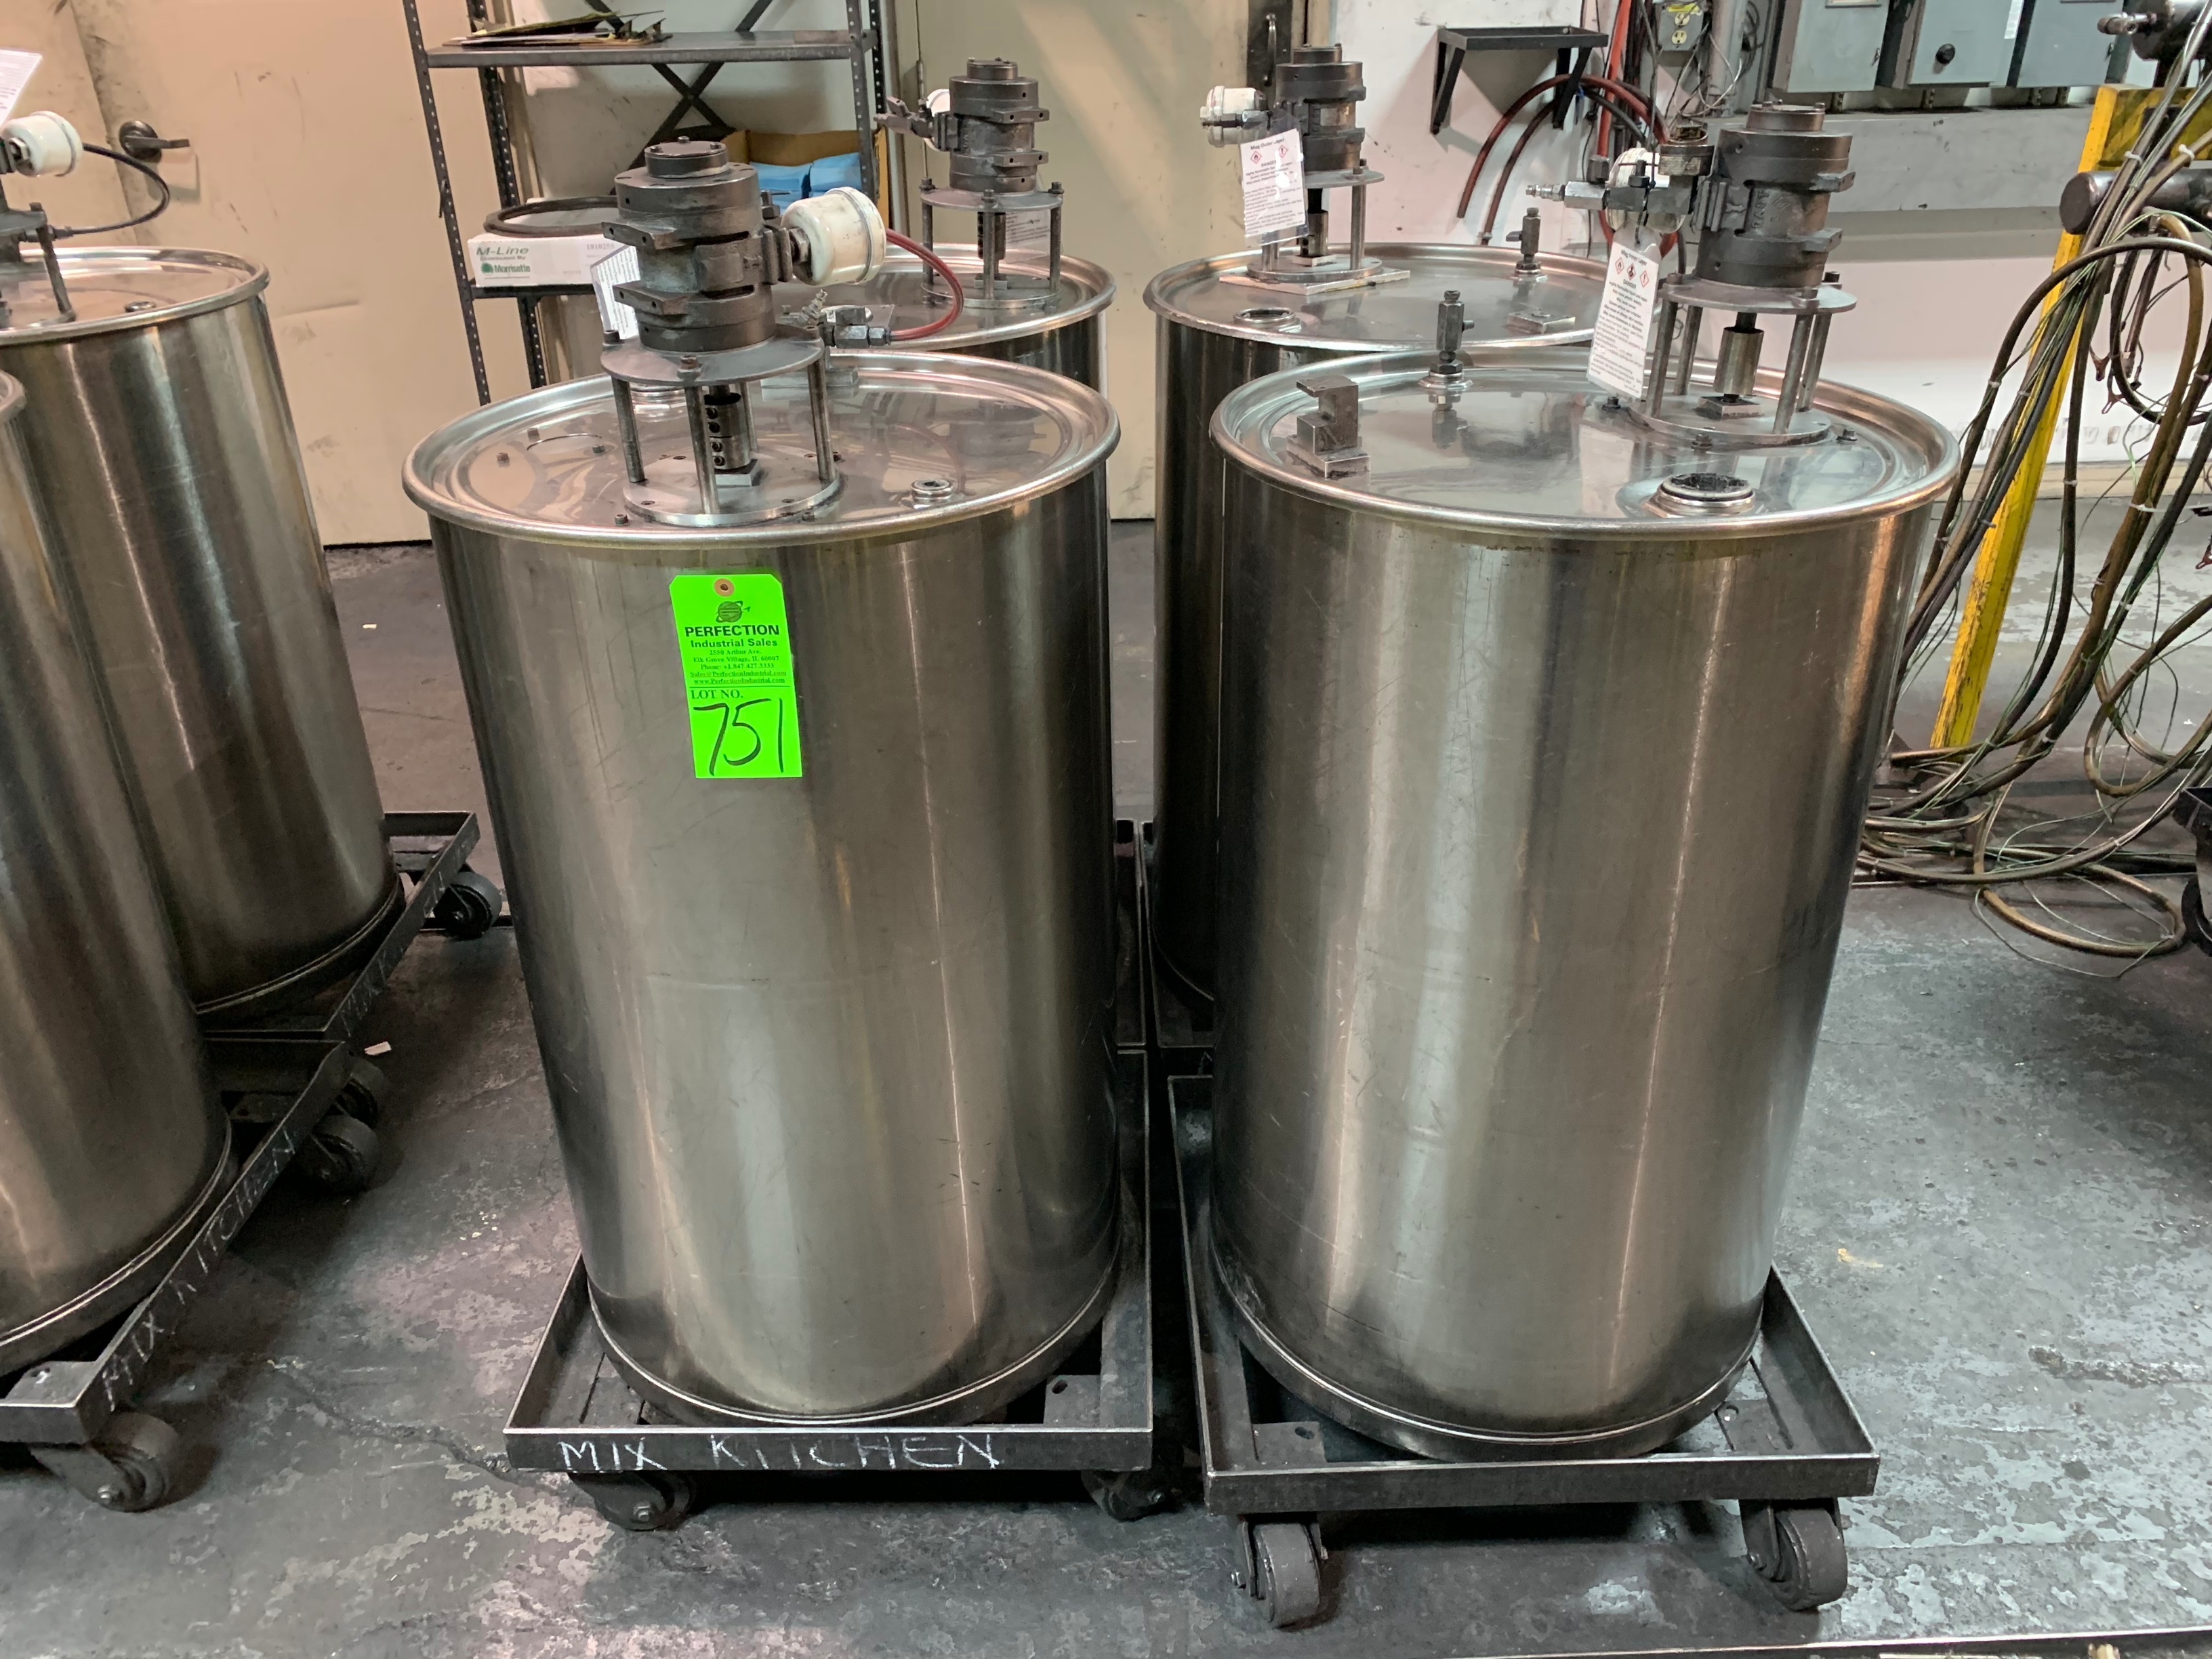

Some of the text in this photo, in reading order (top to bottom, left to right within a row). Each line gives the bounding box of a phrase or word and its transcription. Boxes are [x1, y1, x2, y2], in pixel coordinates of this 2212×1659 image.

[476, 246, 529, 255] M-Line
[494, 264, 531, 272] Morrisette
[684, 625, 779, 637] PERFECTION
[691, 638, 777, 647] Industrial Sales
[691, 689, 743, 699] LOT NO.
[693, 698, 784, 776] 751
[557, 1433, 1006, 1473] MIX KITCHEN
